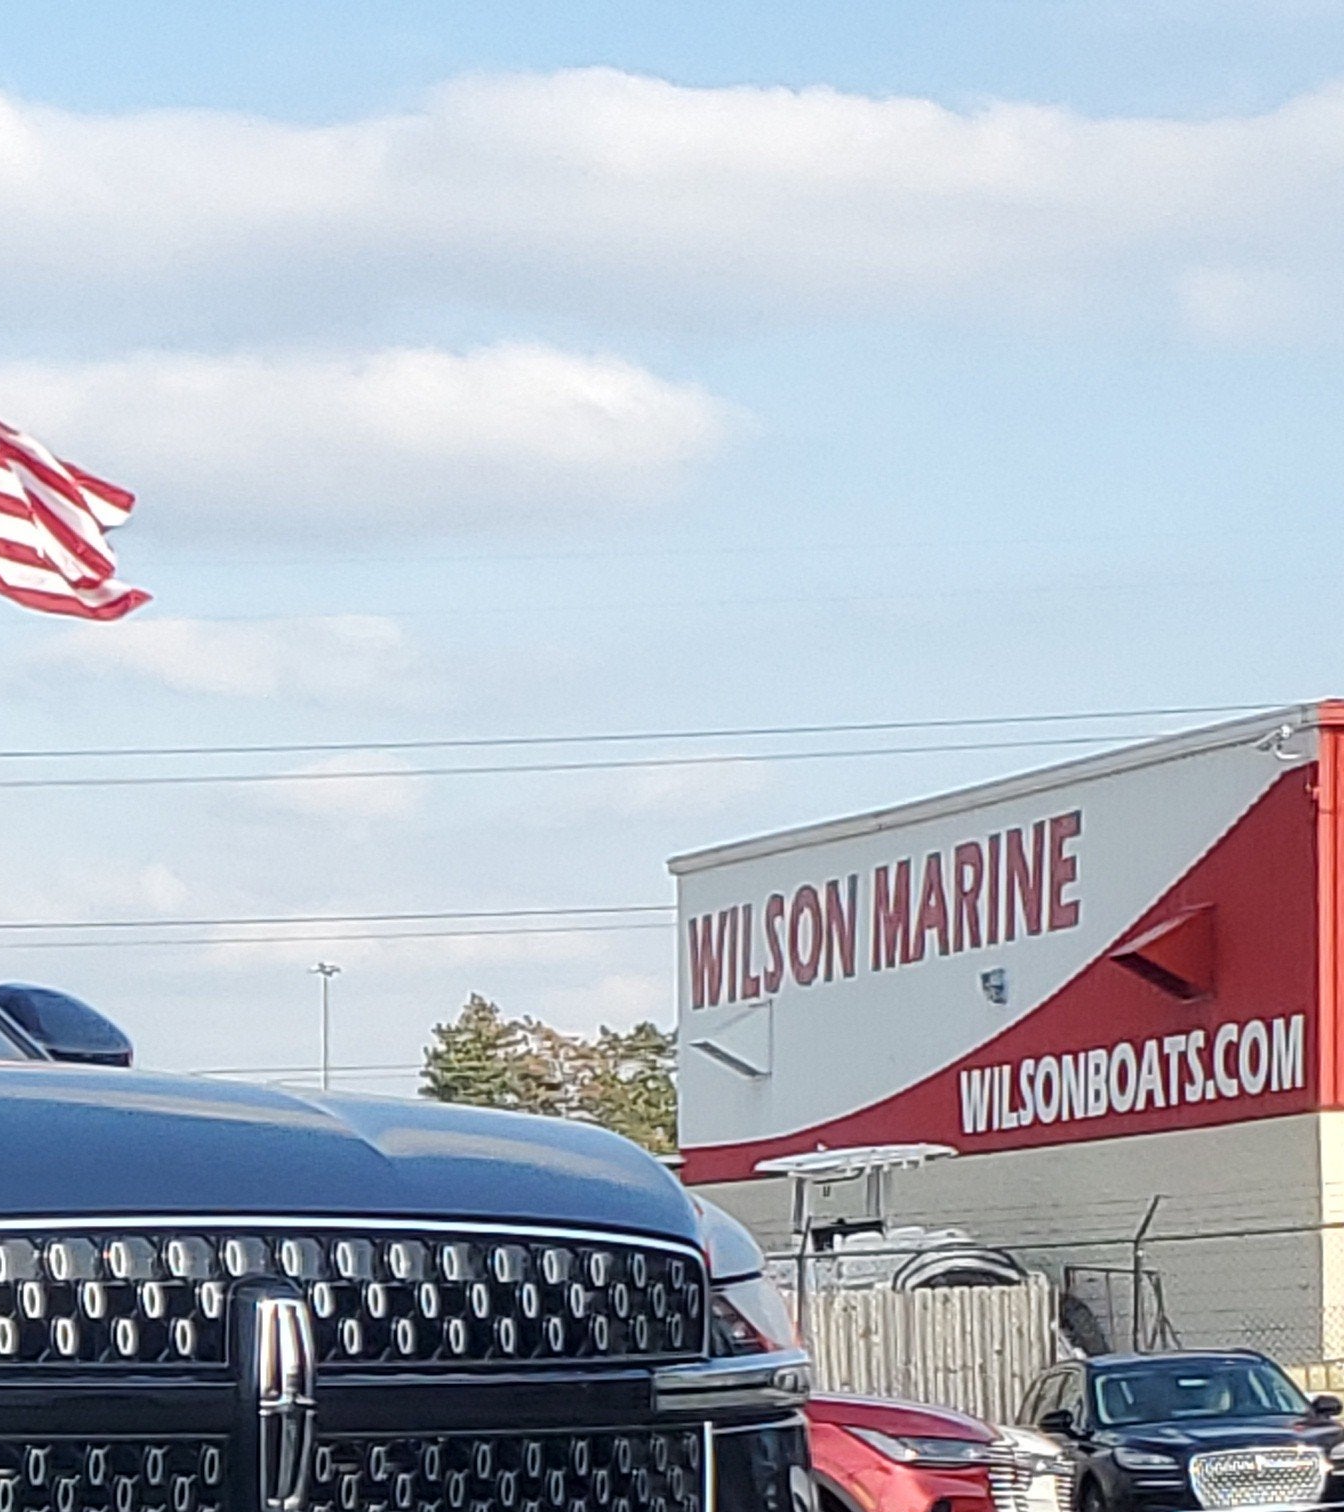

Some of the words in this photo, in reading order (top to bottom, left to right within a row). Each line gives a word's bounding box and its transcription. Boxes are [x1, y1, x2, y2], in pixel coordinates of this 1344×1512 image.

[689, 874, 858, 1010] WILSON
[871, 809, 1082, 972] MARINE
[961, 1014, 1305, 1135] WILSONBOATS.COM
